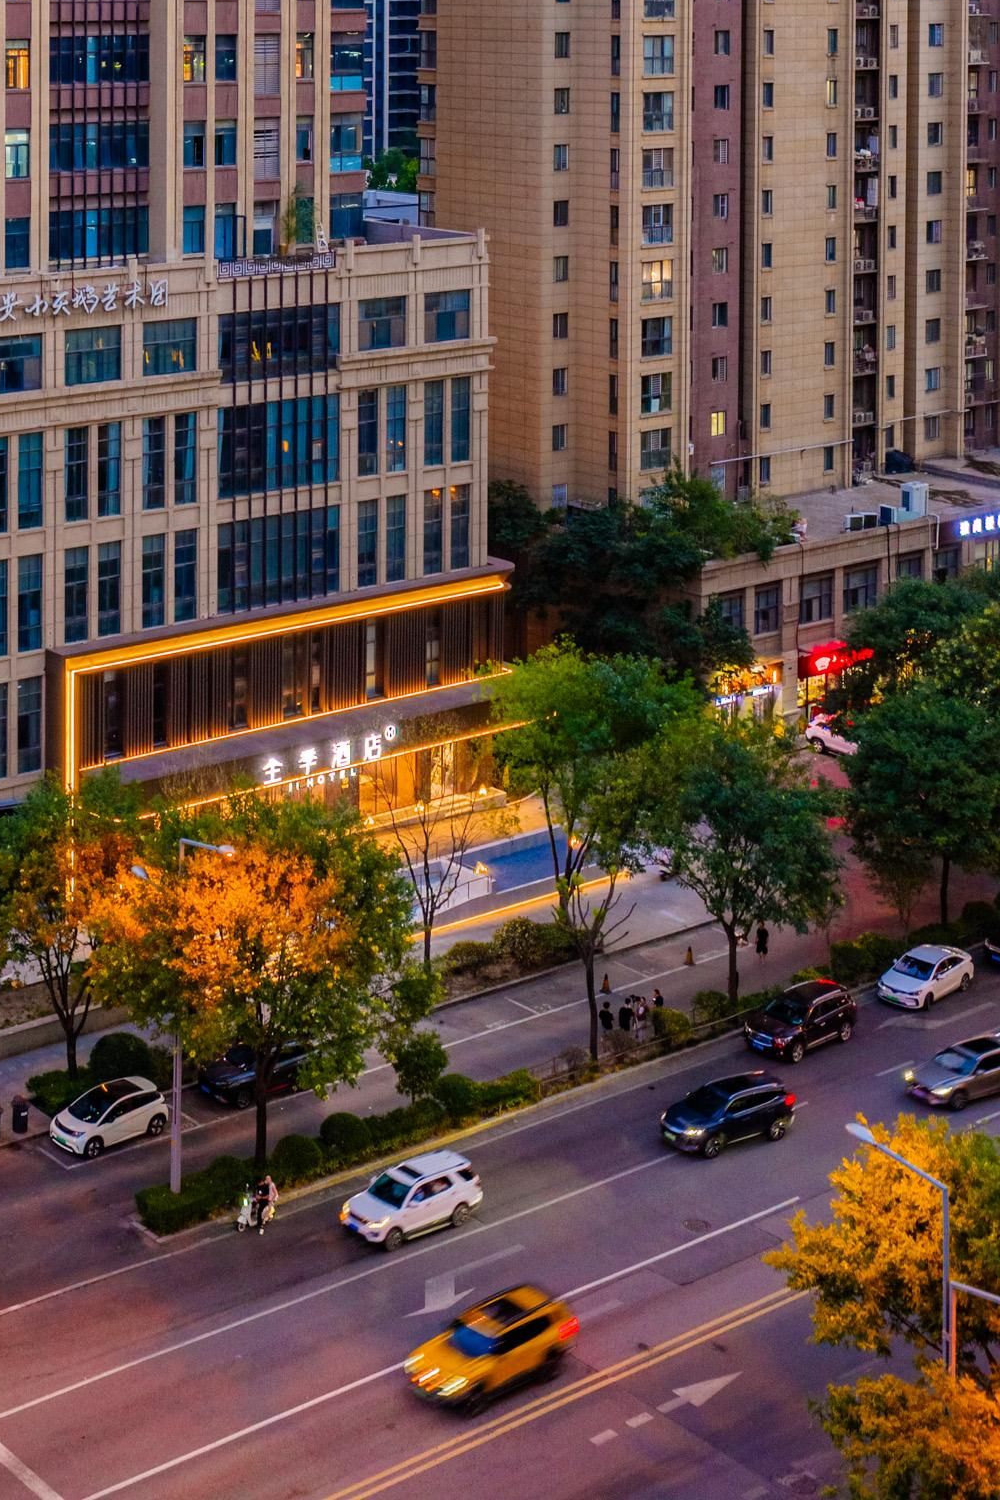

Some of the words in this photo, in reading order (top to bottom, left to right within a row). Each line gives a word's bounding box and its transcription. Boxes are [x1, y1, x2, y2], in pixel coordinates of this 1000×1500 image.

[262, 733, 382, 786] 全季酒店
[306, 767, 357, 788] HOTEL
